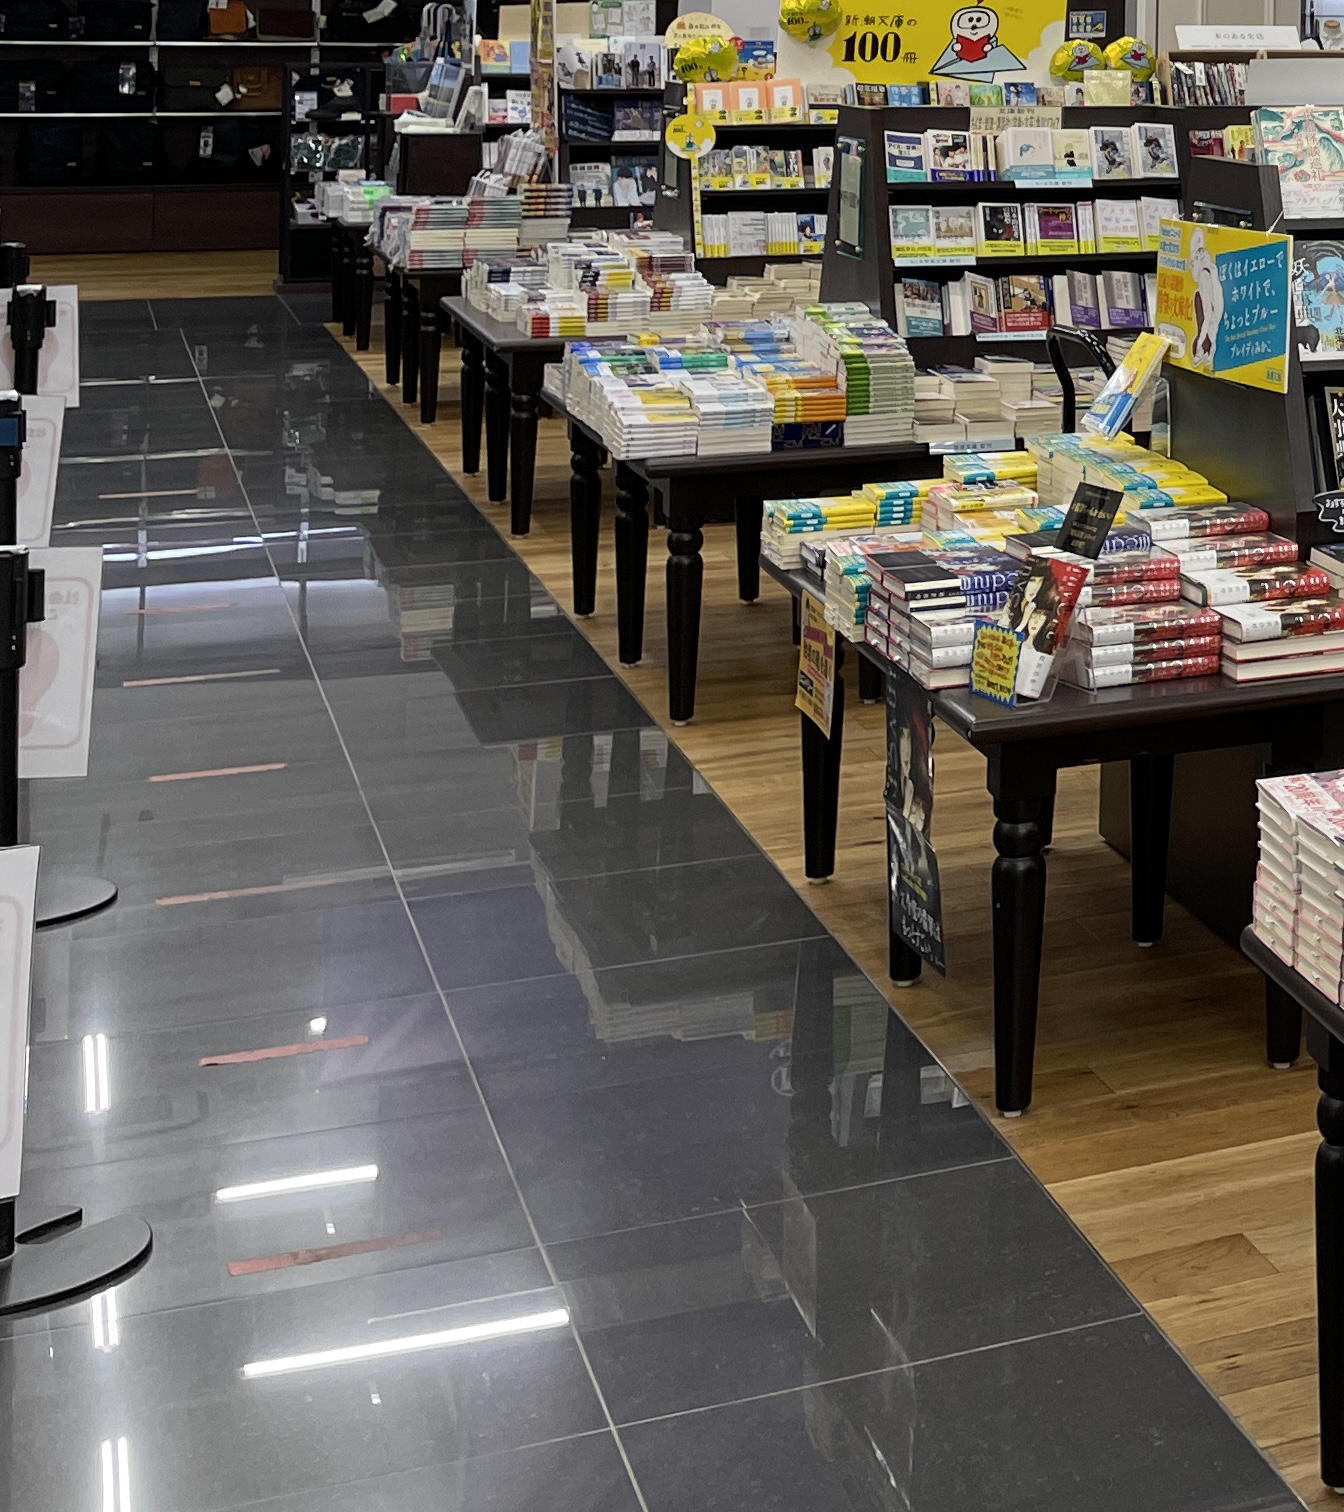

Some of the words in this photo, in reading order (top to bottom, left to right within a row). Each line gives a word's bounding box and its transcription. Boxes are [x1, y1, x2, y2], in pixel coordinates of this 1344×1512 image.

[844, 14, 918, 27] 新潮文庫の
[842, 31, 902, 63] 100
